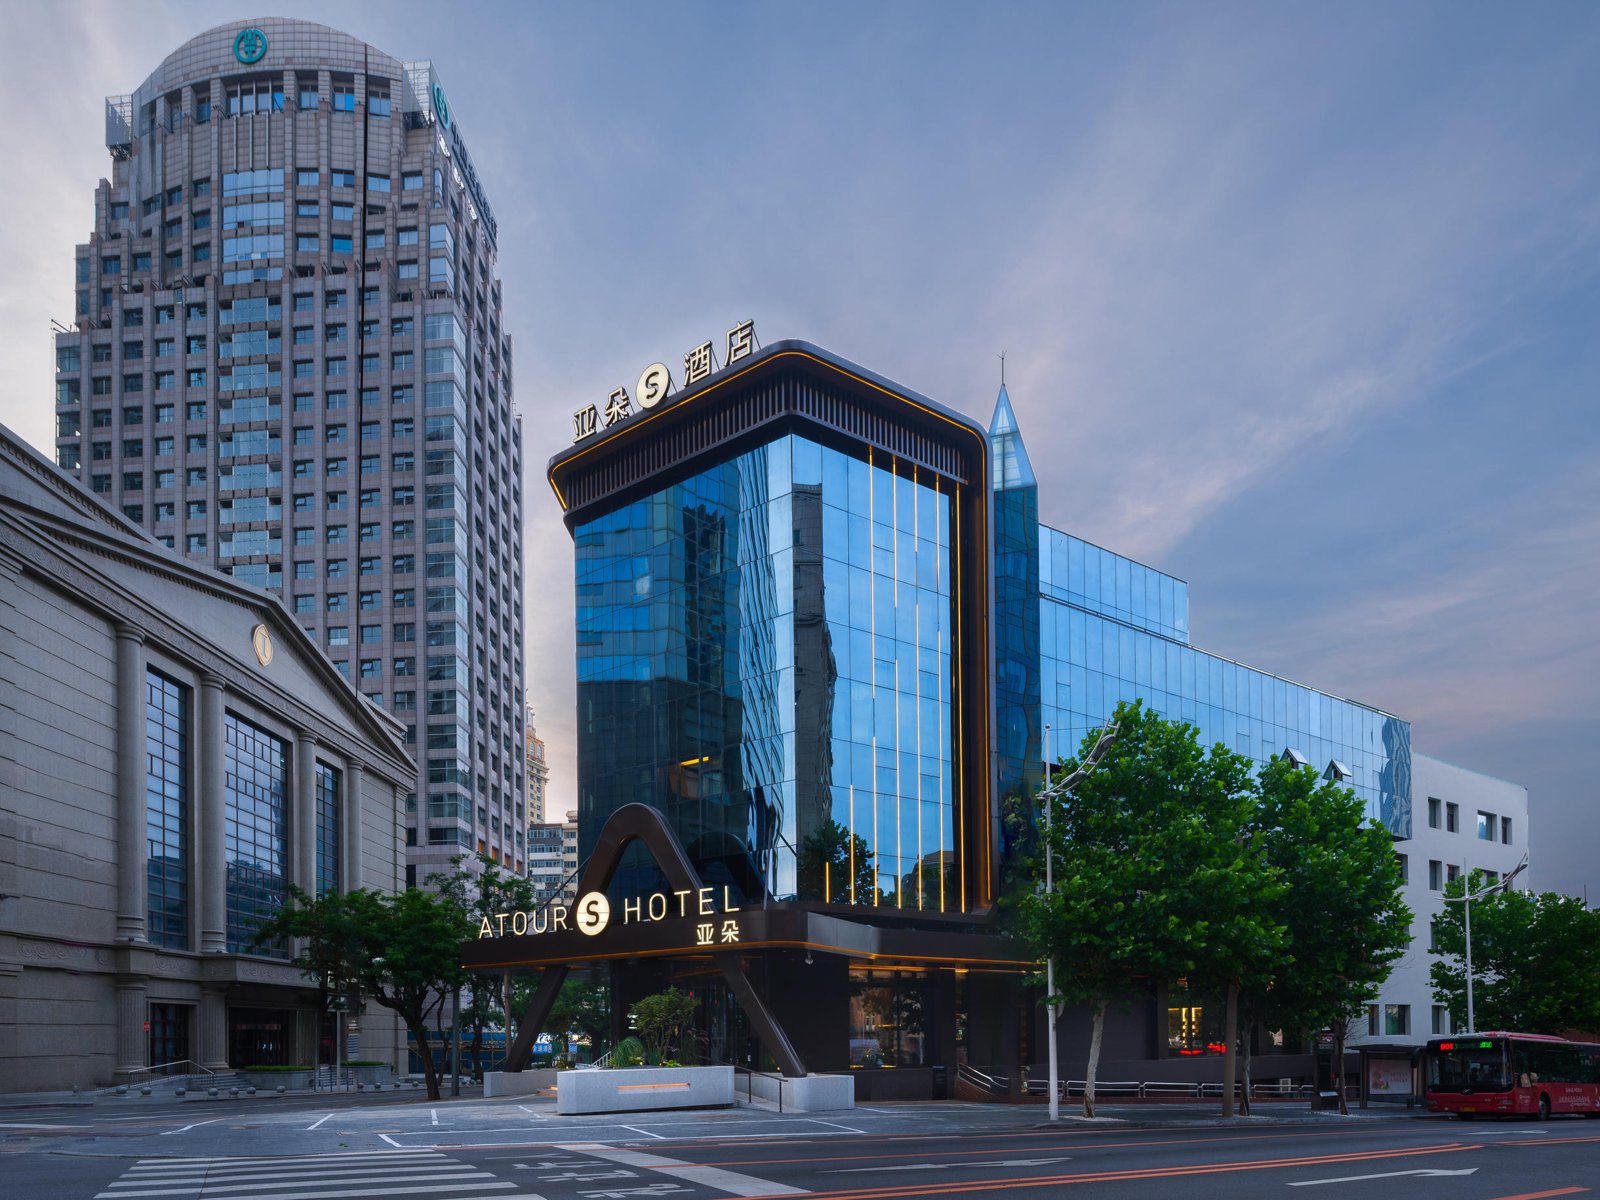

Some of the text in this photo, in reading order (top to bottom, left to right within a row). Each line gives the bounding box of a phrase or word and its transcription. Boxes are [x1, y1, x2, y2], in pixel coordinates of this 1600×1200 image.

[573, 386, 630, 443] 亚朵
[683, 319, 754, 388] 酒店
[479, 885, 740, 939] ATOUR S HOTEL
[696, 920, 739, 945] 亚朵
